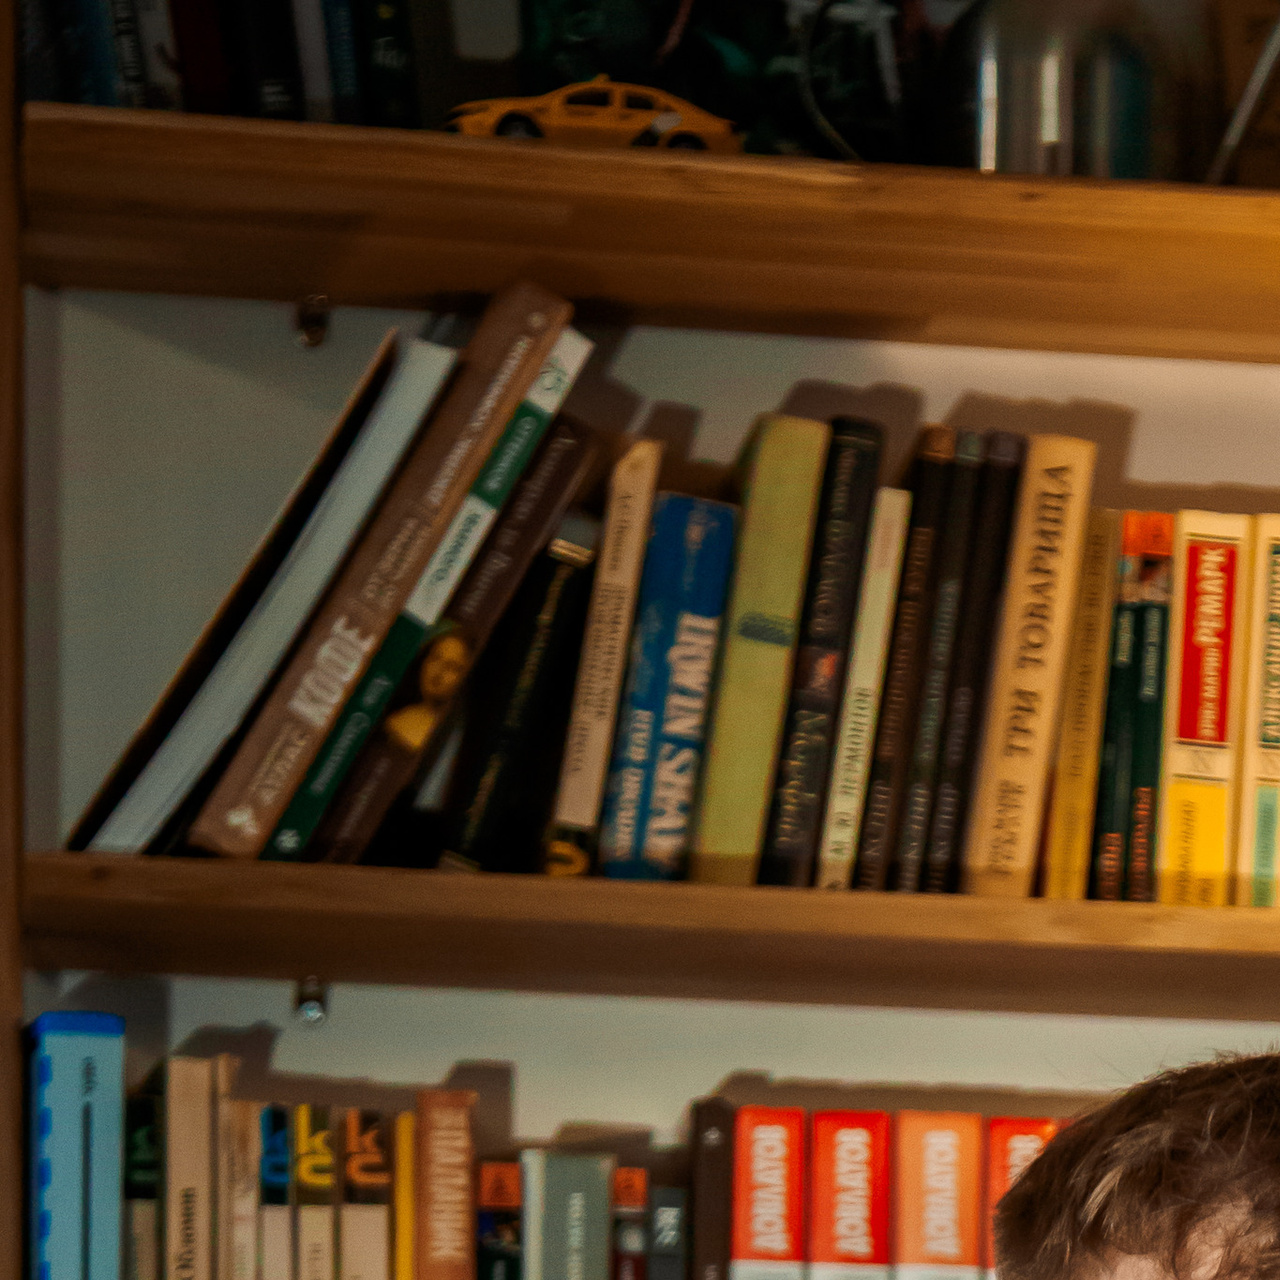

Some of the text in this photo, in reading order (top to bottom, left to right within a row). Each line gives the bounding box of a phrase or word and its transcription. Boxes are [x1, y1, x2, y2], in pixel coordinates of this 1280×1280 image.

[283, 612, 379, 729] КОФЕ
[1001, 464, 1073, 757] ТРИ ТОВАРИЩА
[1192, 546, 1226, 737] ЭРИХ МАРИЯ РЕМАРК
[751, 1123, 790, 1254] ДОВЛАТОВ
[834, 1127, 873, 1256] ДОВЛАТОВ
[923, 1128, 962, 1257] ДОВЛАТОВ
